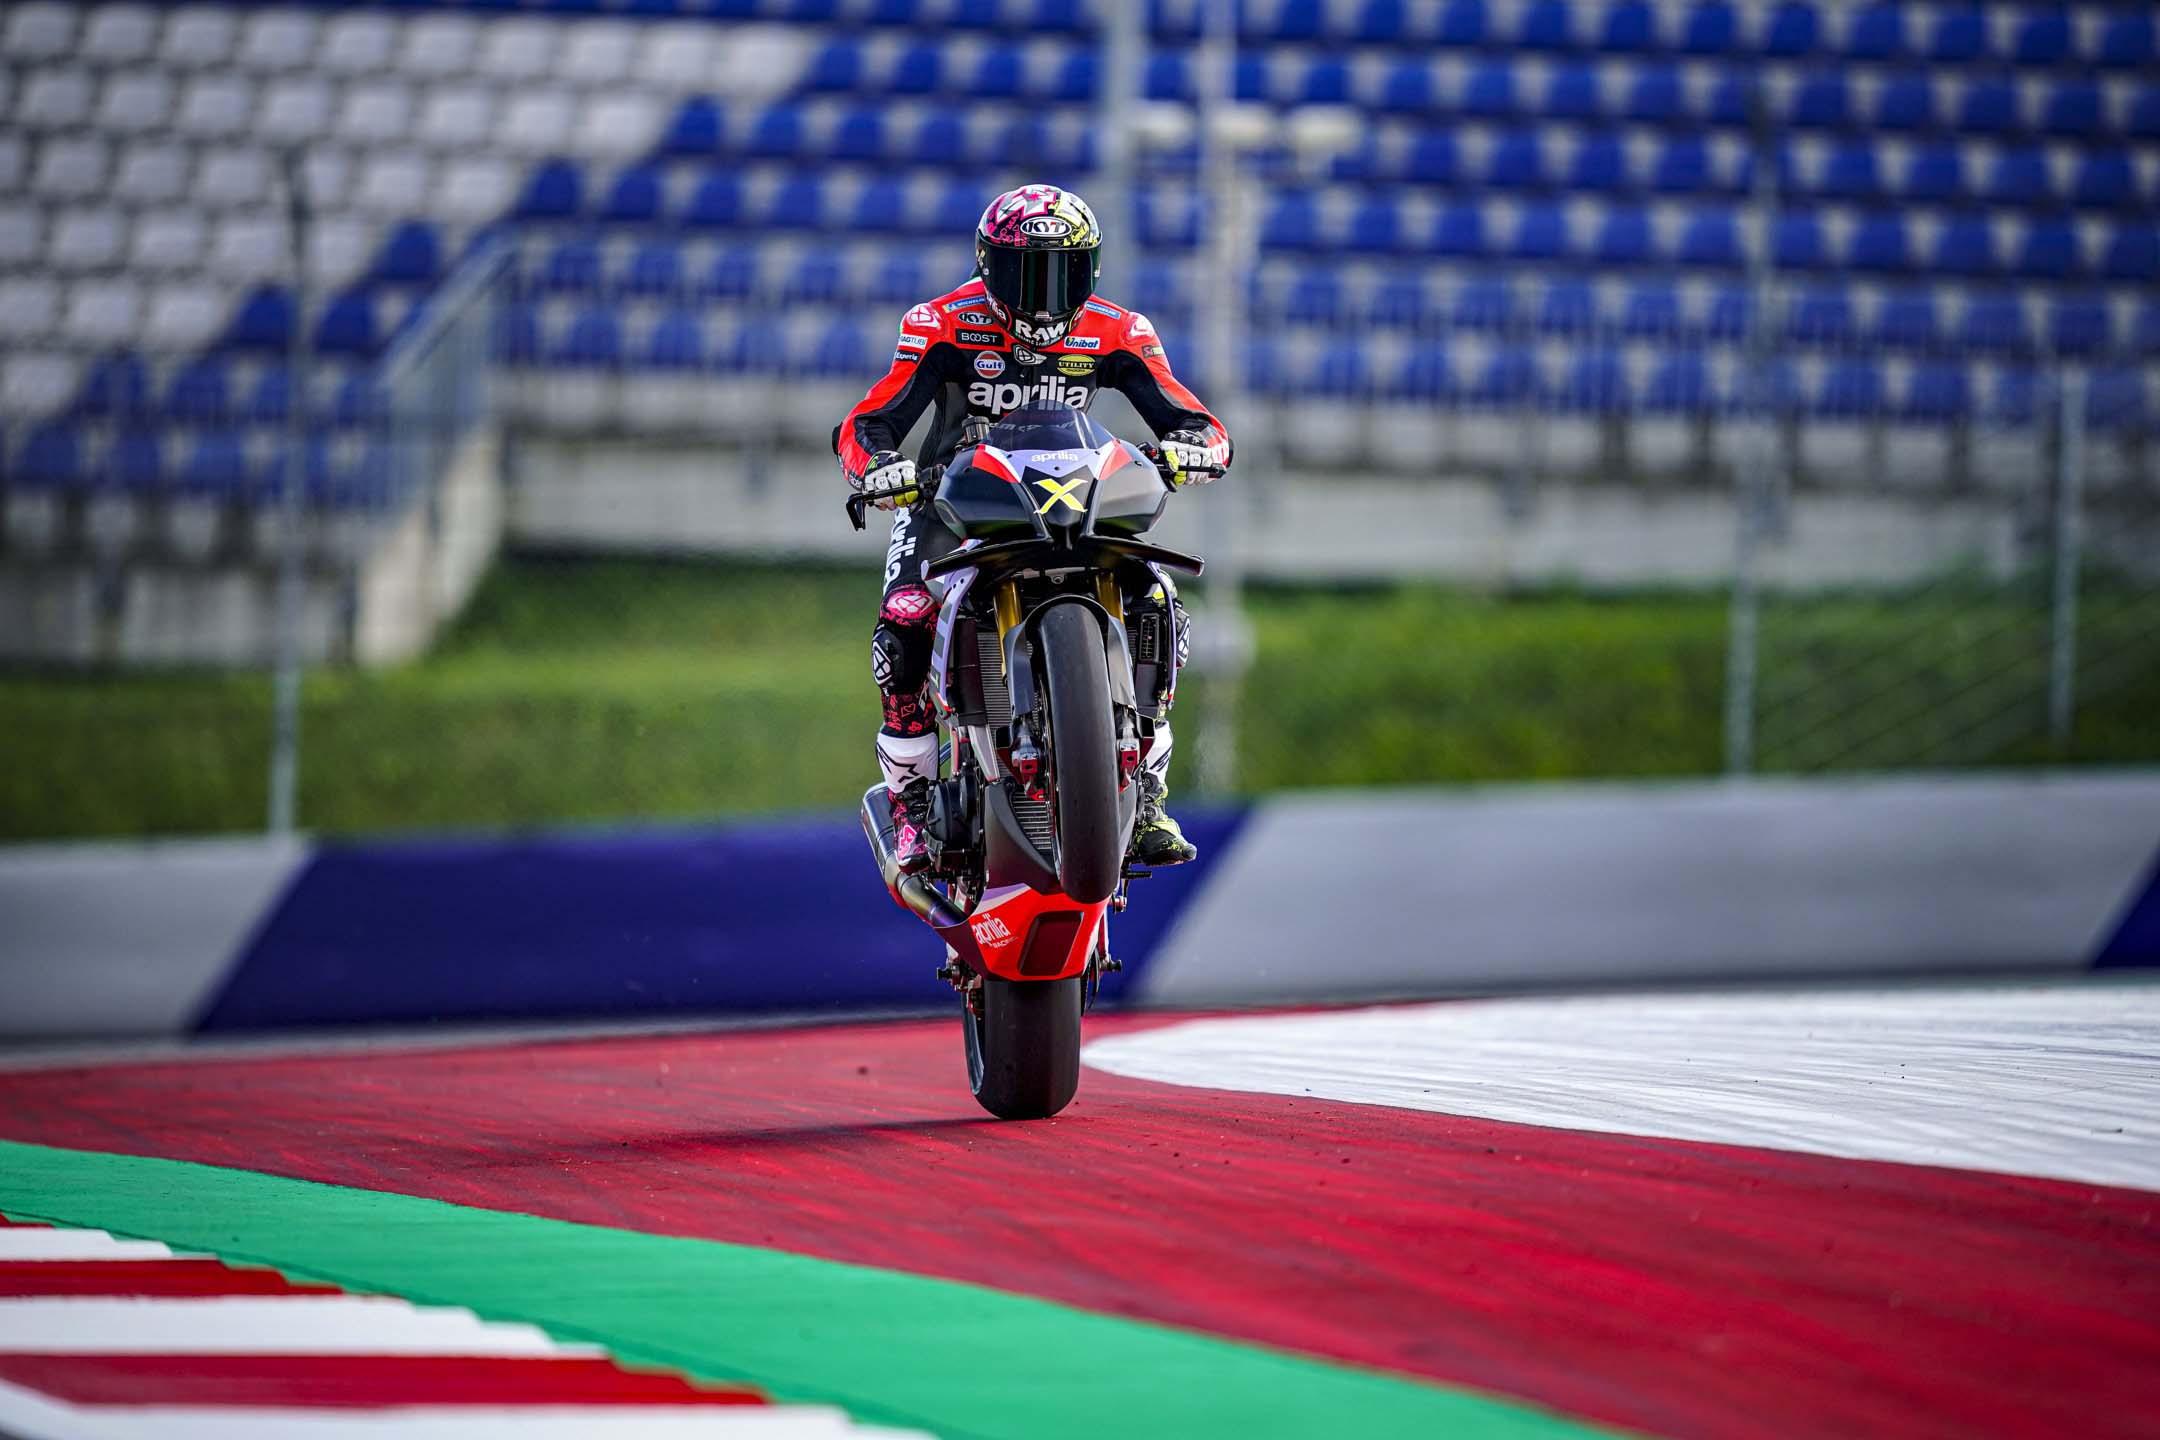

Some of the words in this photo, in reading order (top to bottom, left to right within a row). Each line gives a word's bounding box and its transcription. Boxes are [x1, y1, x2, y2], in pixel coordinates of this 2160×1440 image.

[1023, 220, 1068, 234] KYT
[958, 312, 992, 325] KYT
[1015, 319, 1069, 341] RAW
[961, 332, 998, 343] BOOST
[1065, 336, 1099, 348] Unibat
[976, 360, 1004, 370] Gulf
[1058, 361, 1095, 369] UTILITY
[967, 375, 1089, 415] aprilia
[1031, 450, 1079, 463] aprilia
[971, 912, 1011, 946] aprilia
